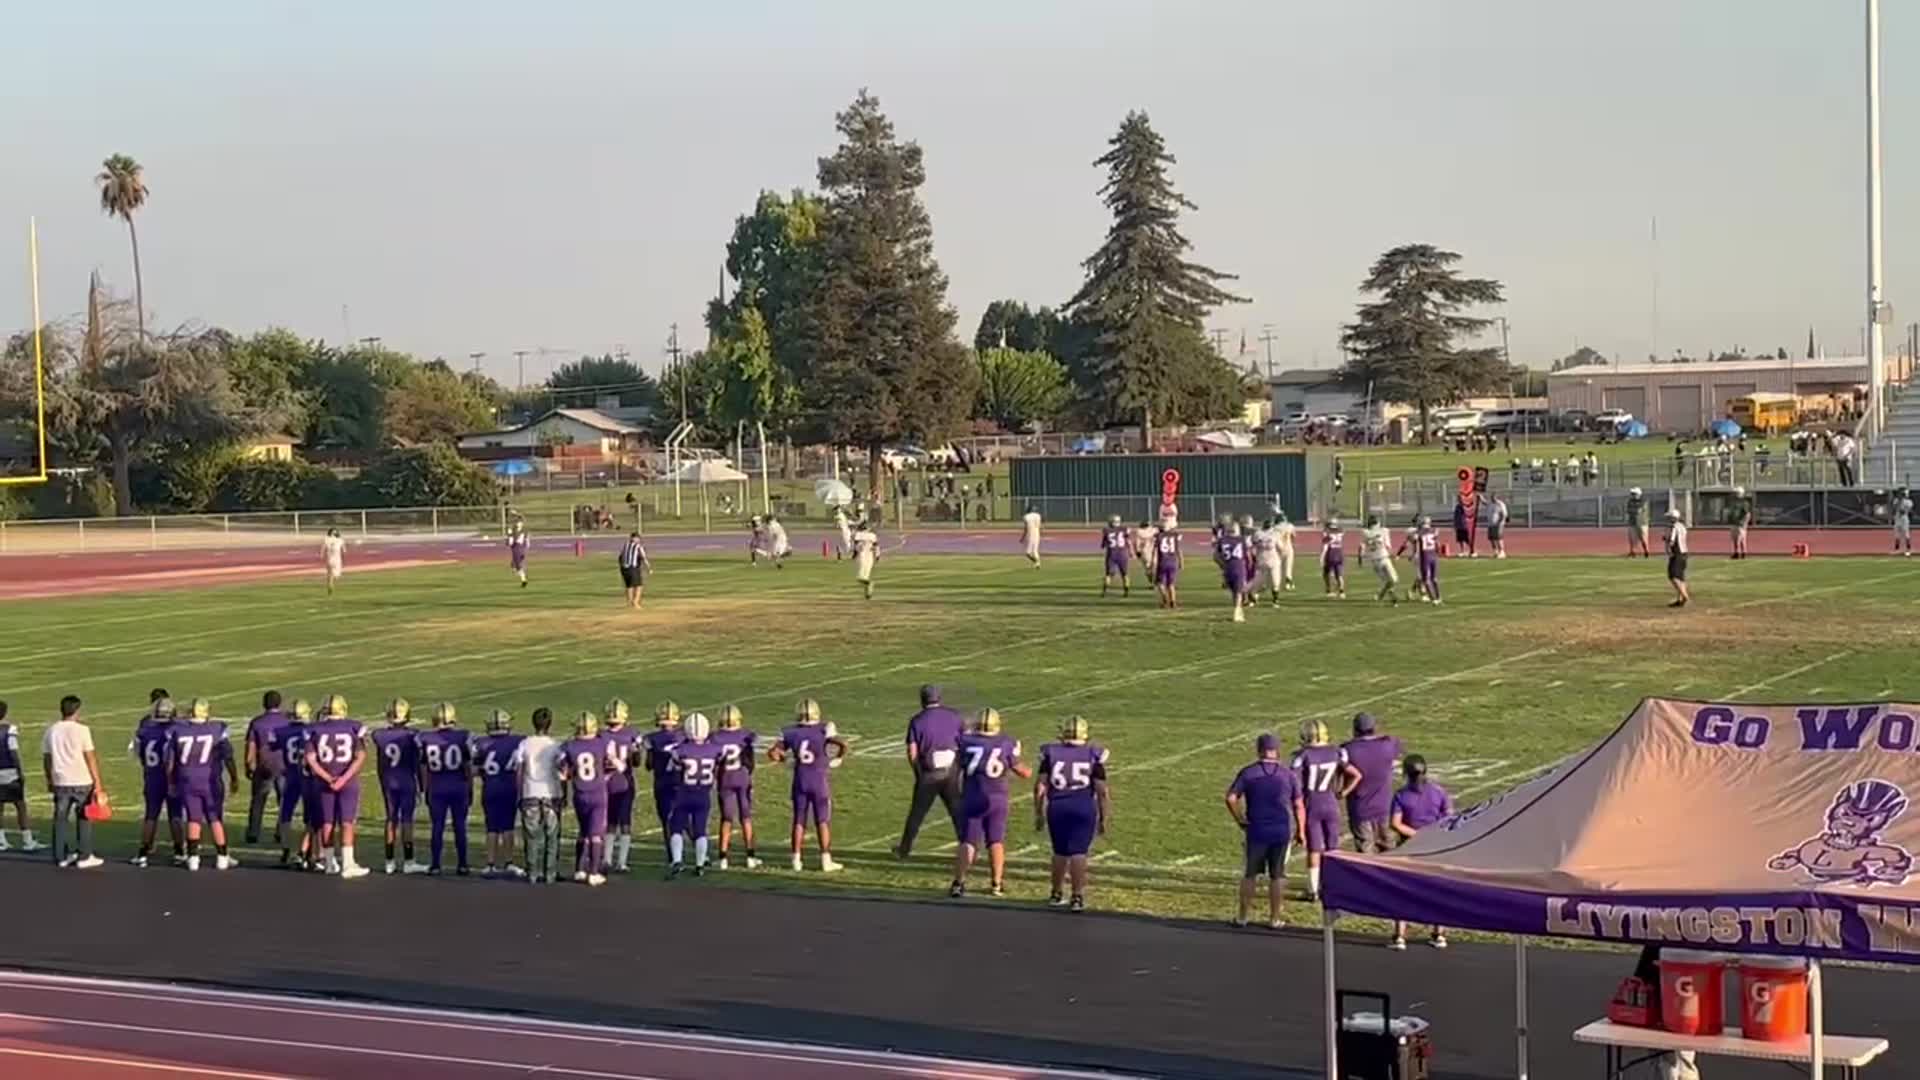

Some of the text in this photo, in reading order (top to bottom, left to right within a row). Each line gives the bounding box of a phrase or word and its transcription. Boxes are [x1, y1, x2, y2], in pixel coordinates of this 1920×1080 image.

[1159, 536, 1175, 553] 61
[1221, 543, 1243, 560] 54
[1421, 533, 1436, 550] 15
[145, 740, 160, 767] 6
[178, 734, 213, 764] 77
[318, 733, 353, 762] 63
[385, 743, 401, 768] 9
[426, 744, 462, 772] 80
[798, 739, 815, 764] 6
[577, 752, 597, 781] 8
[684, 758, 715, 785] 23
[965, 747, 1004, 779] 76
[1050, 761, 1091, 790] 65
[1307, 762, 1337, 792] 17
[1546, 896, 1842, 949] LIVINGSTON
[1674, 975, 1694, 997] G
[1751, 981, 1771, 1003] G
